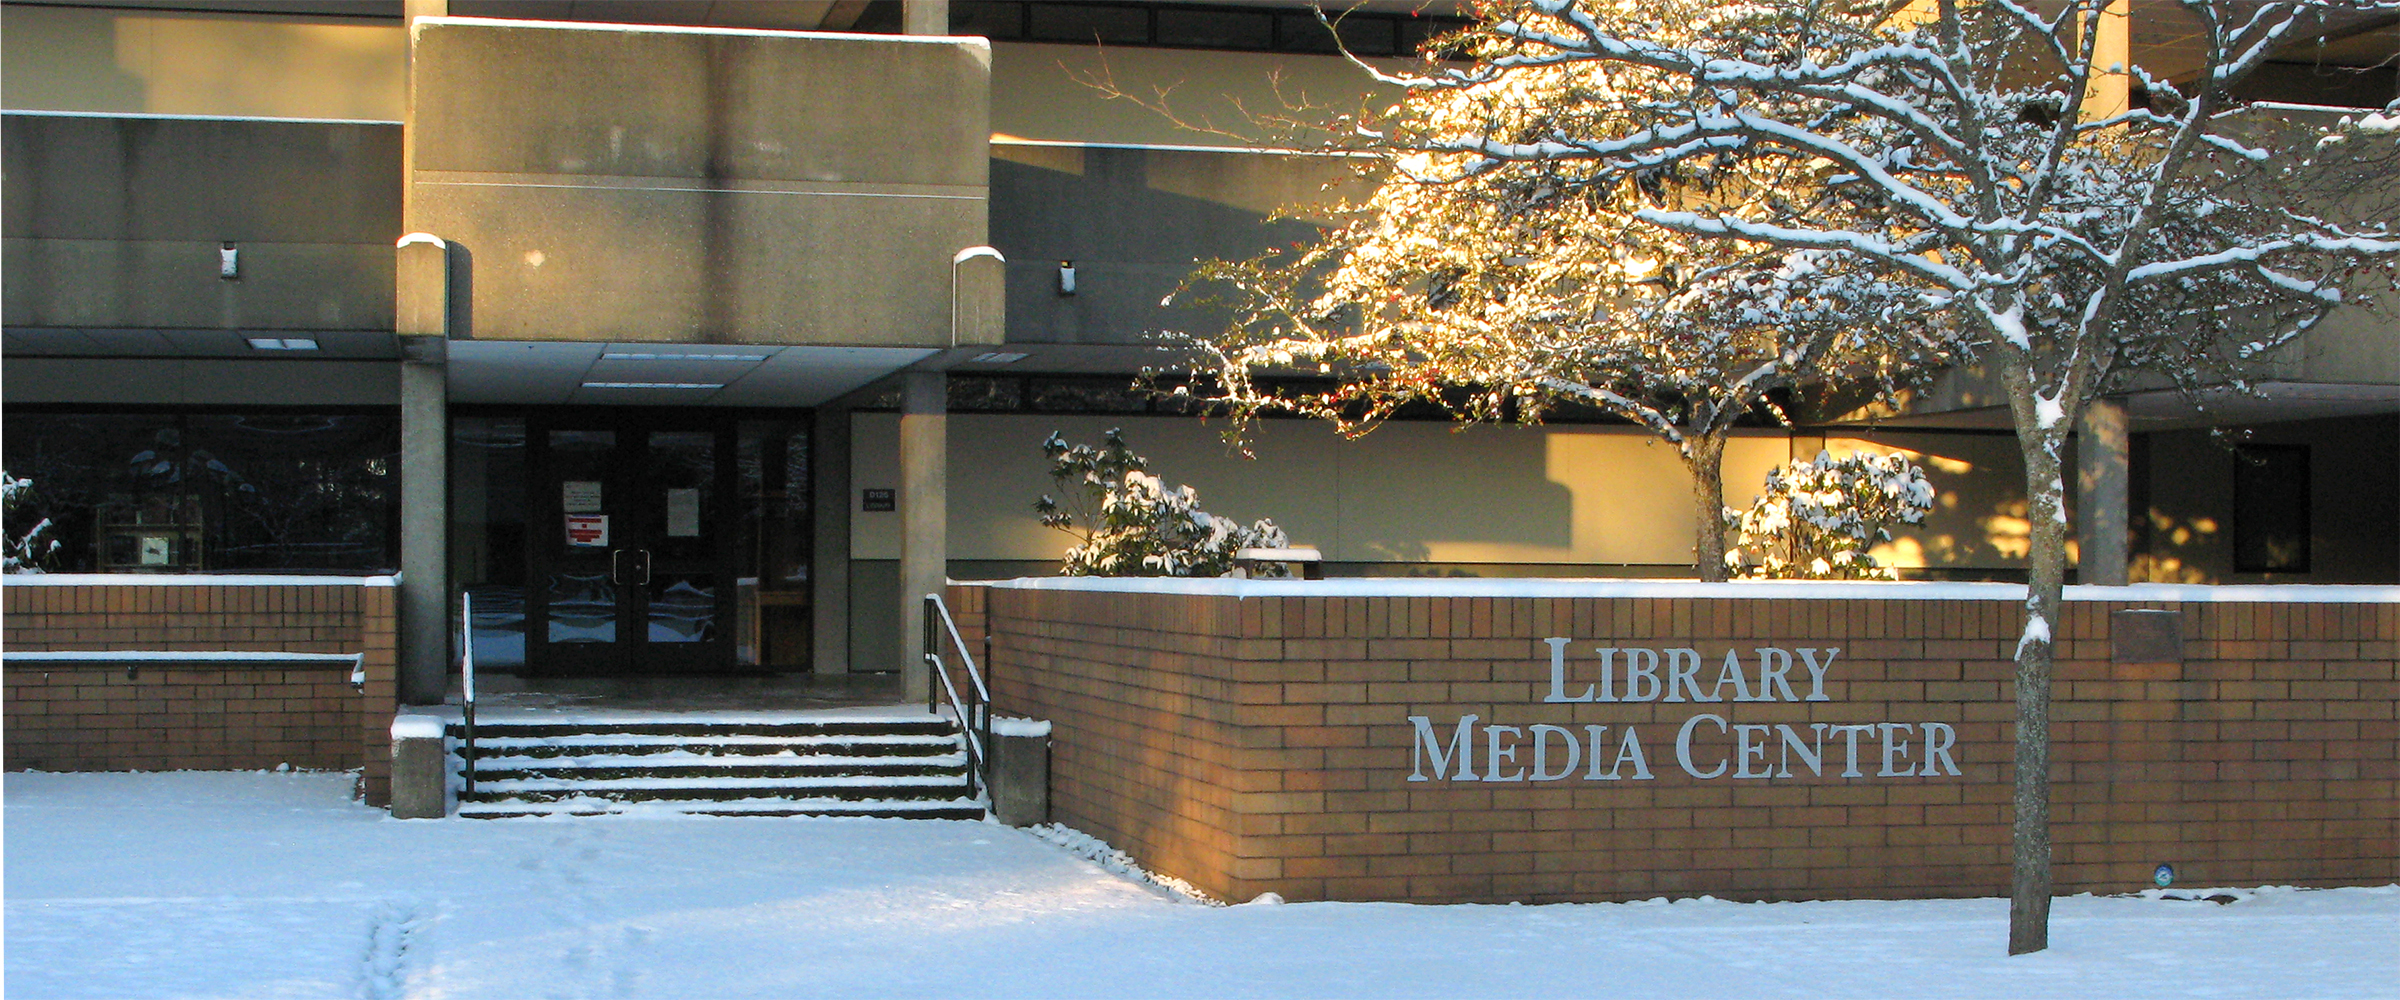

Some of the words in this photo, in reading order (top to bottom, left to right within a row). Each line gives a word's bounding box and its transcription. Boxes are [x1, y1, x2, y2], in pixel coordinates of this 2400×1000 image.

[1544, 637, 1841, 702] LIBRARY
[1408, 713, 1656, 782] MEDIA
[1676, 713, 1962, 779] CENTER
